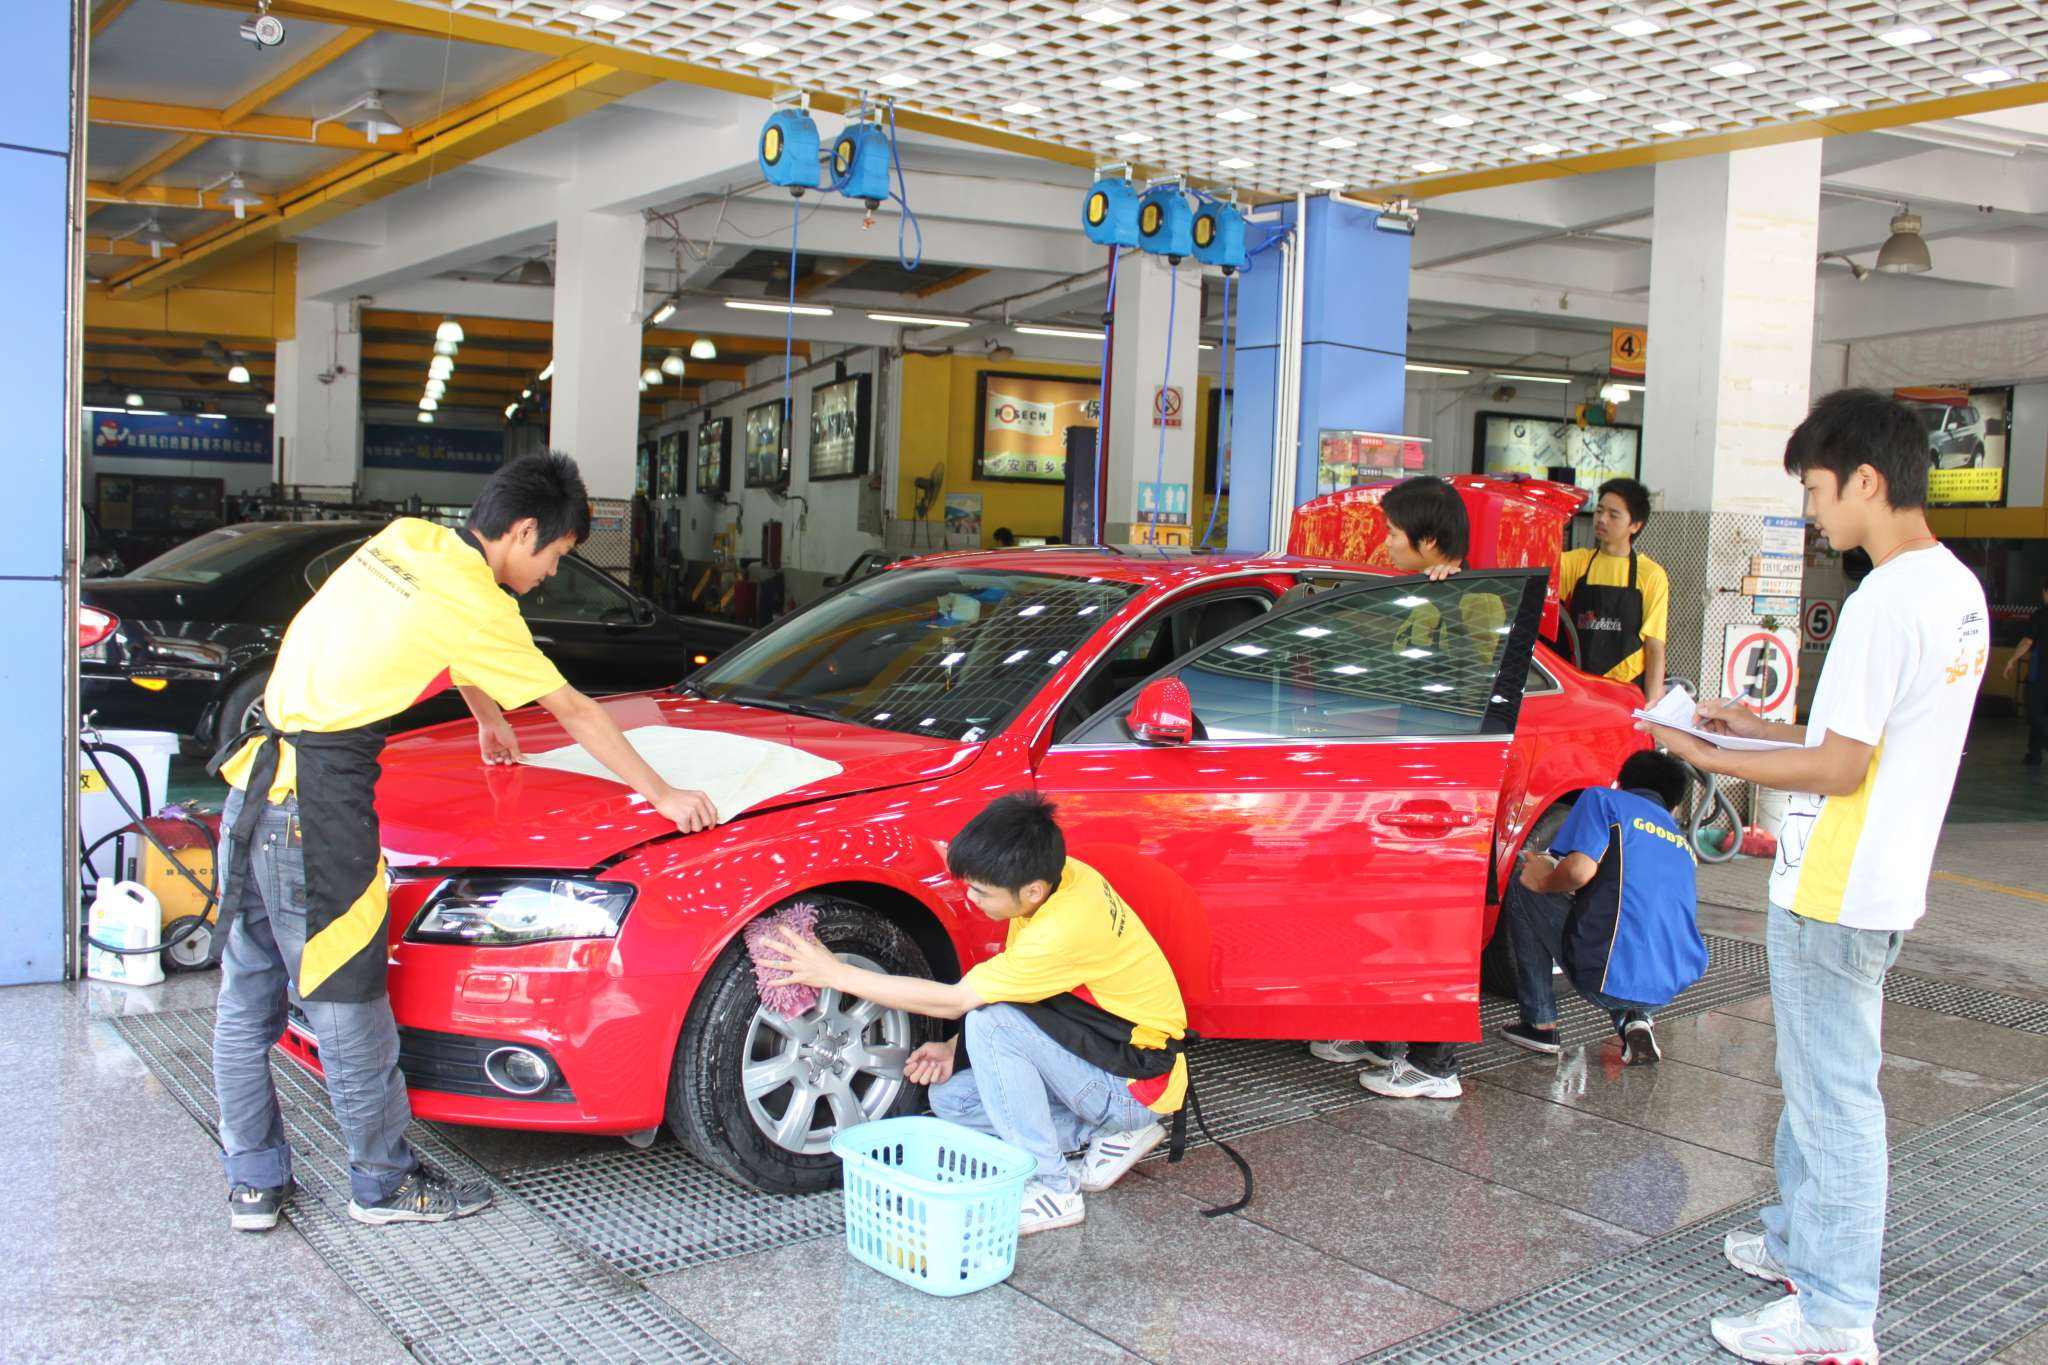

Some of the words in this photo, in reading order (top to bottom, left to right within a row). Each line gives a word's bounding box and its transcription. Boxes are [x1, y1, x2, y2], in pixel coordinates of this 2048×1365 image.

[1620, 335, 1634, 357] 4
[1812, 609, 1829, 634] 5
[1744, 647, 1779, 699] 5
